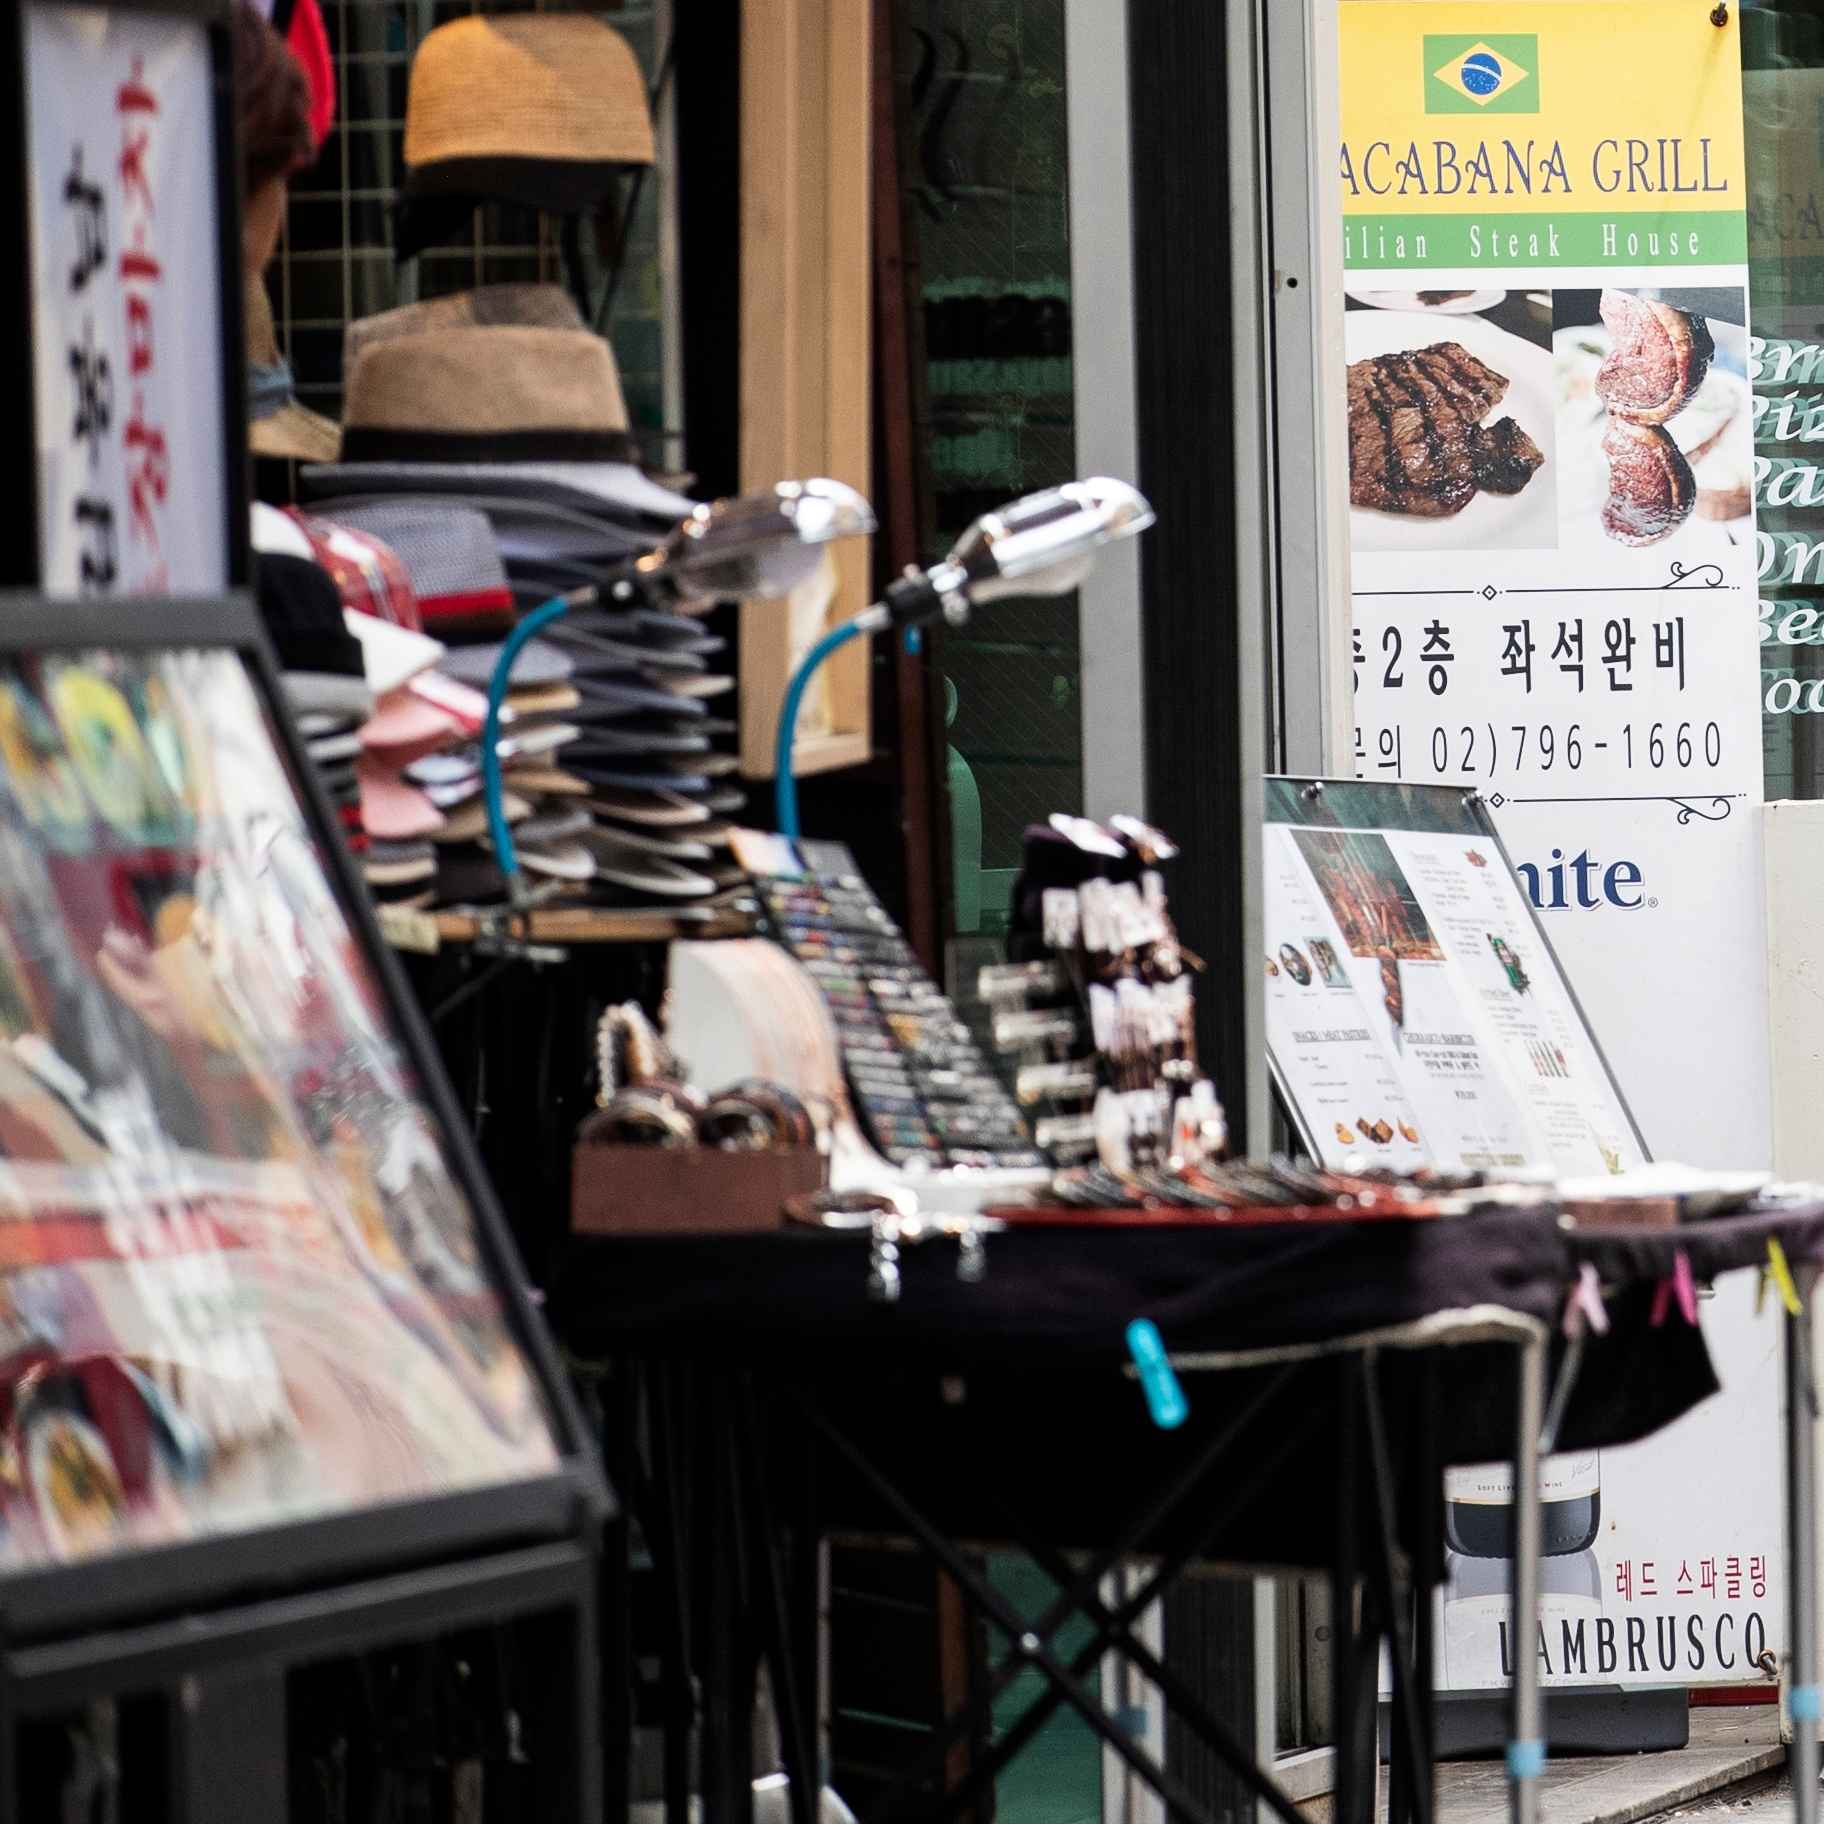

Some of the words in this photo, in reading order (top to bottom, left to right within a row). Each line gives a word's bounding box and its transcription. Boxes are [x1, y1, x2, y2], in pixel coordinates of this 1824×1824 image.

[1593, 138, 1728, 193] GRILL
[1470, 224, 1561, 258] Steak
[1603, 223, 1700, 257] House
[1500, 616, 1685, 694] 좌석완비
[1616, 1559, 1658, 1601] 레드
[1676, 1555, 1767, 1601] 스파클링
